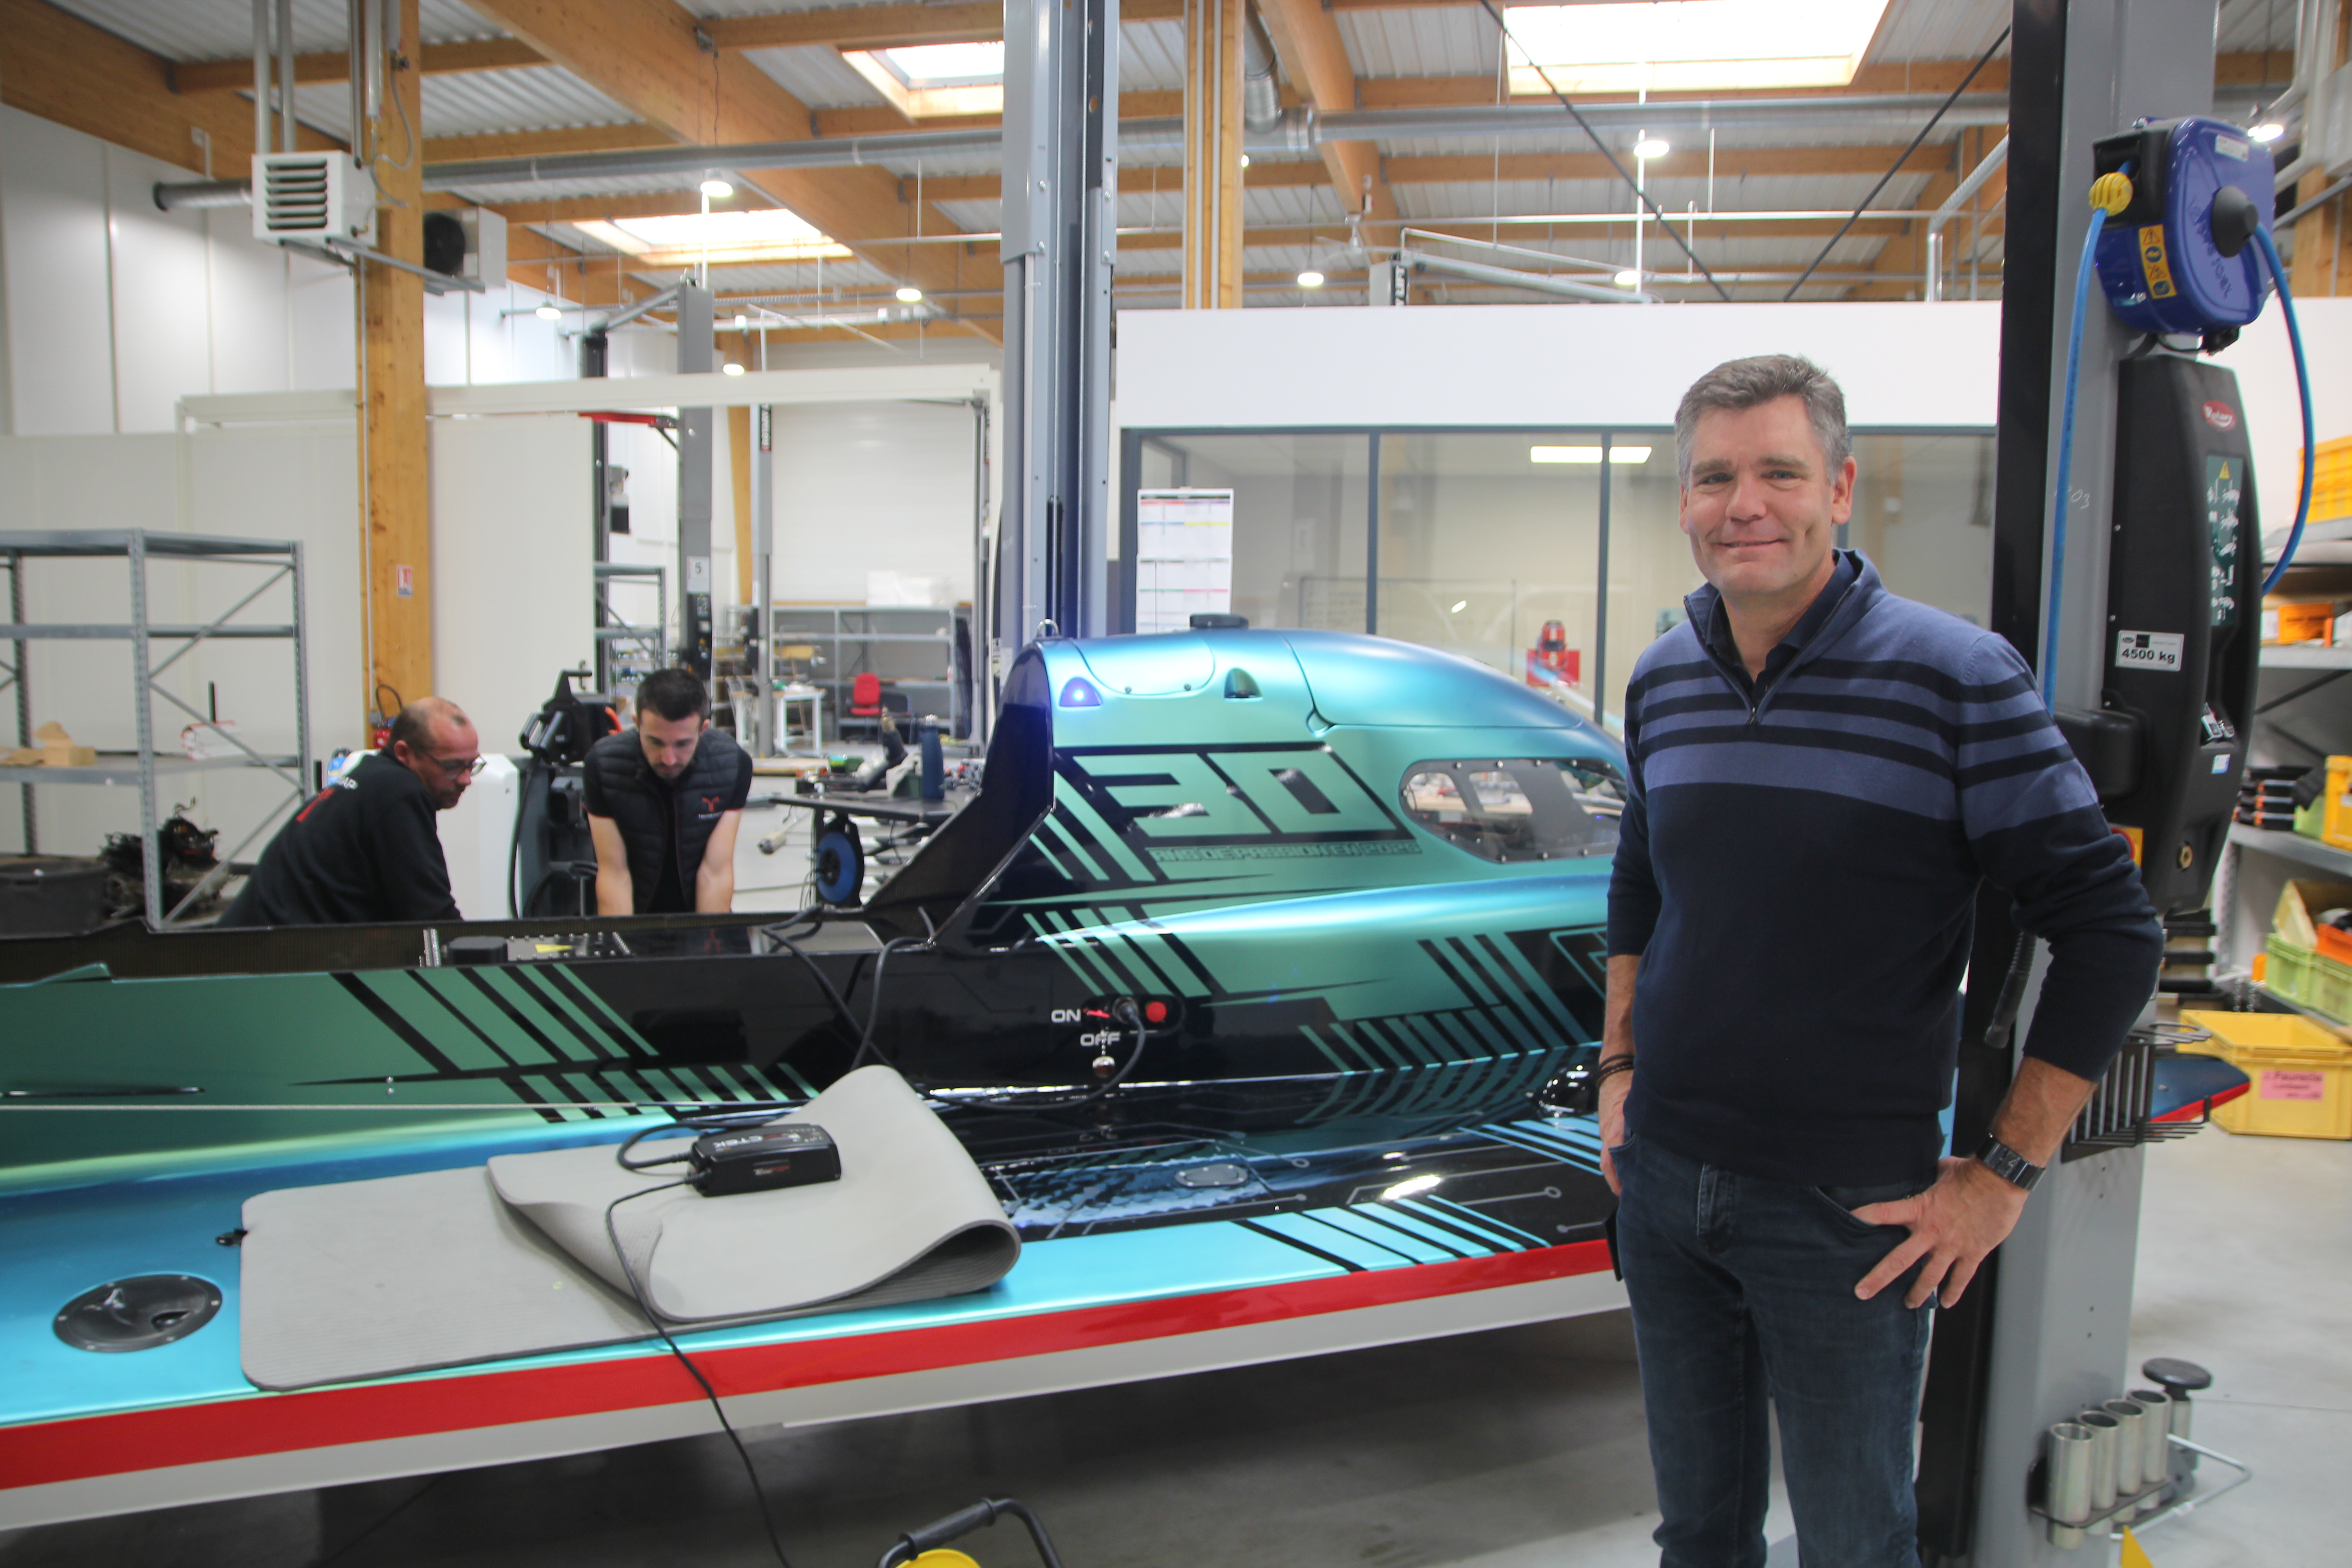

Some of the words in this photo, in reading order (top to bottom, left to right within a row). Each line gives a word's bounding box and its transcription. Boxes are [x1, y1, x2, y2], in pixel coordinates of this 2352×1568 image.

[1395, 265, 1405, 297] LIFT
[695, 562, 701, 574] 5
[2122, 648, 2155, 660] 4500
[2159, 651, 2176, 664] kg
[1198, 848, 1234, 860] DE
[1051, 1008, 1082, 1023] ON
[1080, 1031, 1121, 1047] OFF
